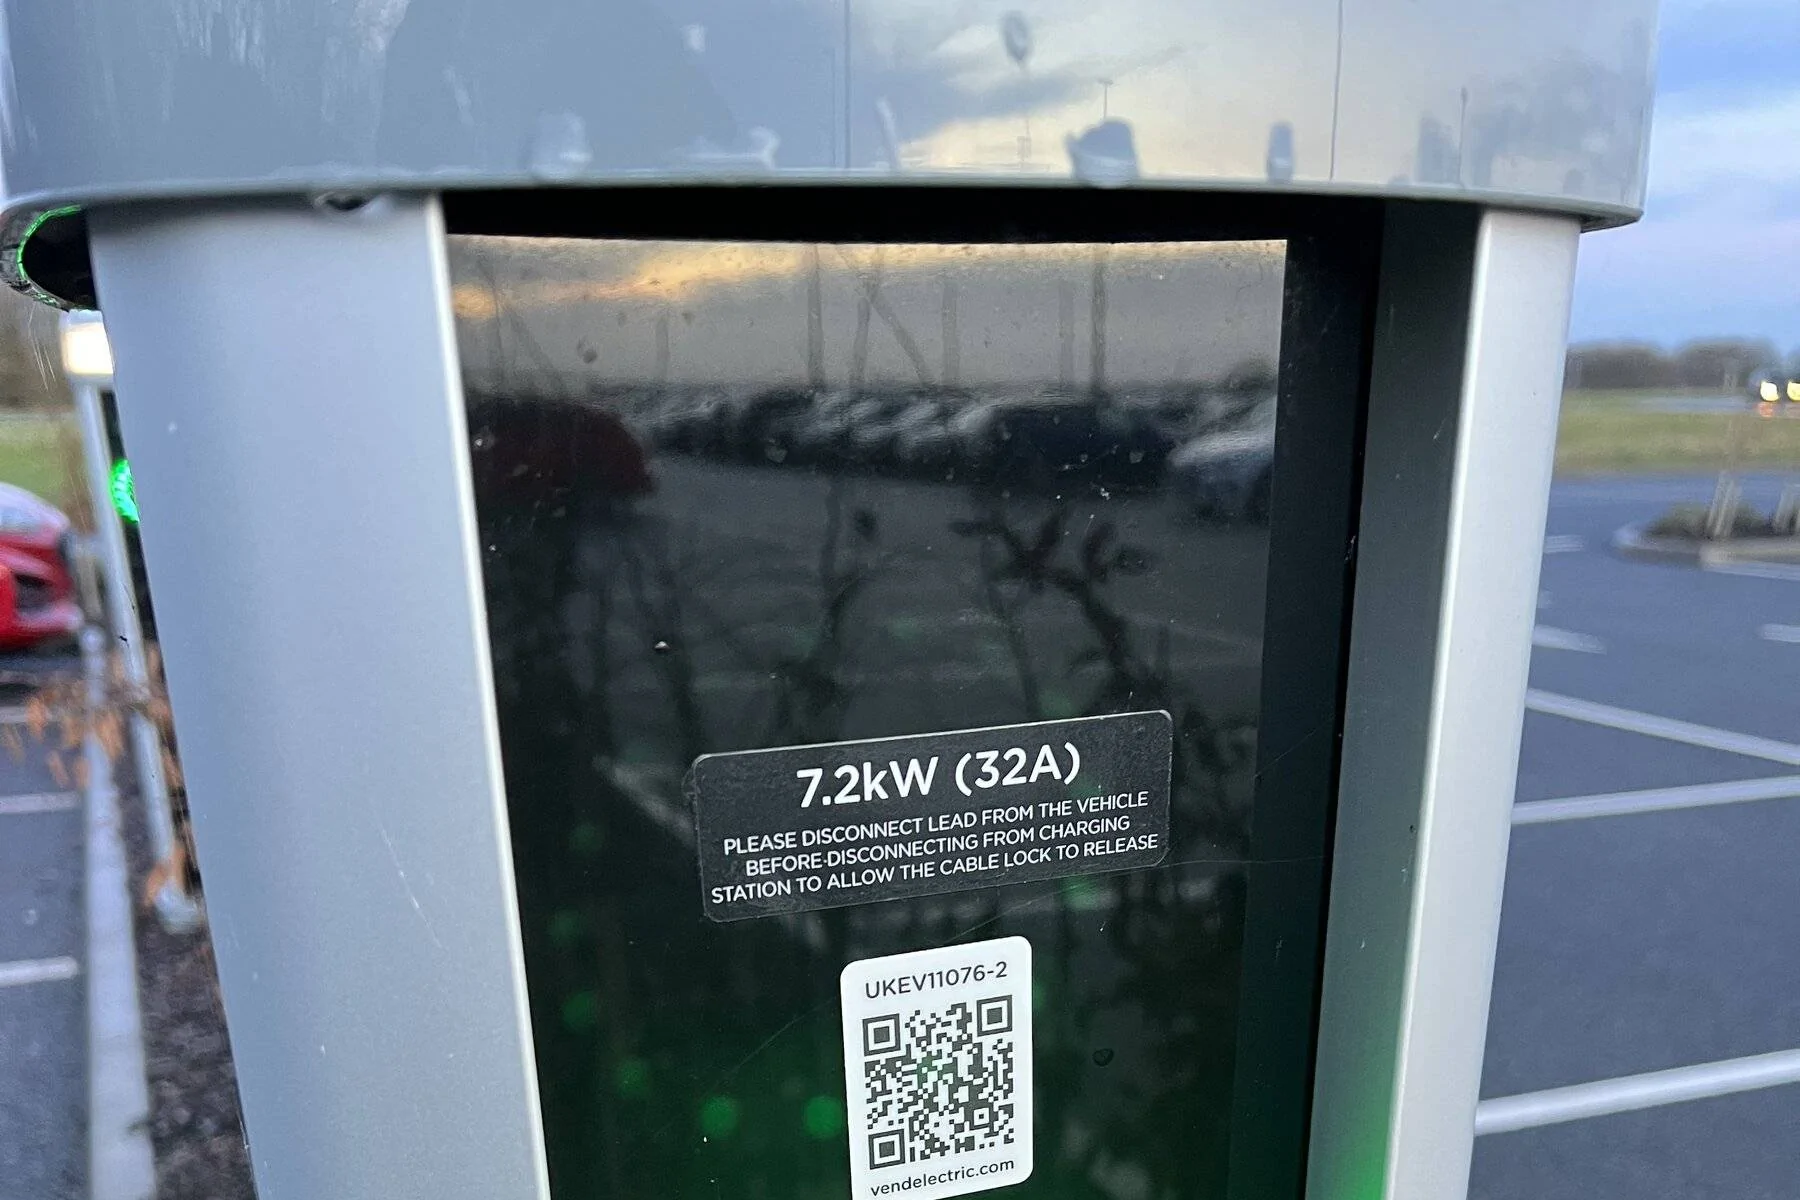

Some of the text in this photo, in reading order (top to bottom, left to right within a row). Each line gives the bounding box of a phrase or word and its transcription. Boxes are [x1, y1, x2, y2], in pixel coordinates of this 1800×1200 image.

[796, 742, 1081, 809] 7.2kW (32A)
[724, 791, 1149, 855] PLEASE DISCONNECT LEAD FROM THE VEHICLE
[746, 815, 1130, 877] BEFORE DISCONNECTING FROM CHARGING
[711, 833, 1158, 904] STATION TO ALLOW THE CABLE LOCK TO RELEASE
[865, 961, 1008, 999] UKEV11076-2
[870, 1158, 1015, 1197] vendelectric.com
